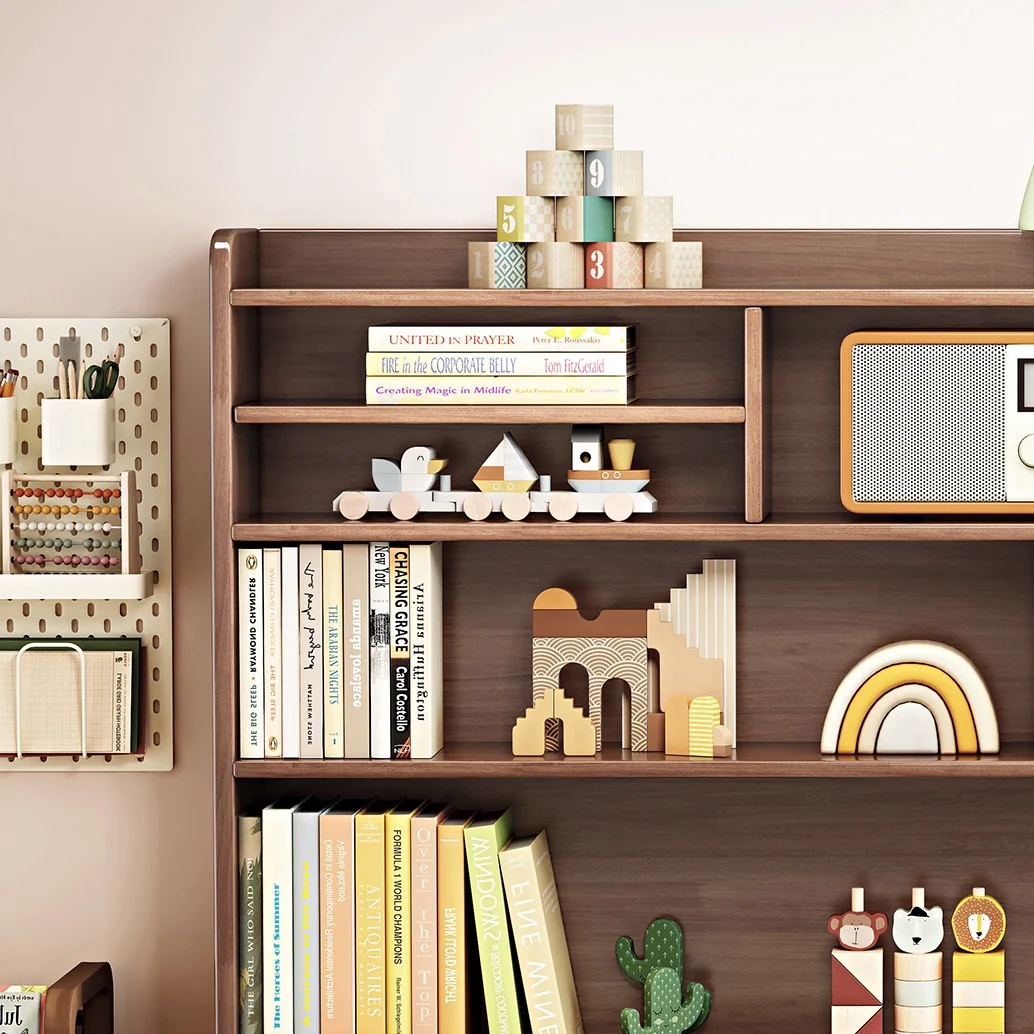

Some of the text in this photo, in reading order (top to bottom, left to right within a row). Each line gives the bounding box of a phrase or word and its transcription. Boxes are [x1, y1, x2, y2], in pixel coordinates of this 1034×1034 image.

[558, 115, 576, 136] 10
[531, 160, 544, 185] 8
[589, 158, 605, 188] 9
[502, 204, 516, 233] 5
[561, 206, 574, 231] 6
[621, 206, 633, 233] 7
[474, 251, 482, 279] 1
[531, 251, 544, 278] 2
[590, 250, 604, 280] 3
[649, 251, 663, 279] 4
[389, 335, 445, 345] UNITED
[449, 336, 461, 345] IN
[464, 335, 515, 345] PRAYER
[532, 336, 552, 344] Peter
[564, 336, 601, 344] Roussakis
[381, 358, 605, 374] FIRE in the CORPORATE BELLY Tom FitzGerald
[375, 386, 512, 396] Creating Magic in Midlife
[374, 546, 388, 588] New York
[395, 551, 408, 652] CHASING GRACE
[329, 605, 339, 705] THE ARABIAN NIGHTS
[396, 666, 408, 731] Carol Costello
[393, 830, 402, 872] FORMULA
[416, 827, 431, 889] Over
[393, 880, 402, 912] WORLD
[393, 913, 402, 965] CHAMPIONS
[419, 909, 430, 954] the
[273, 943, 280, 956] of
[364, 883, 383, 1017] ANTIQUAIRES
